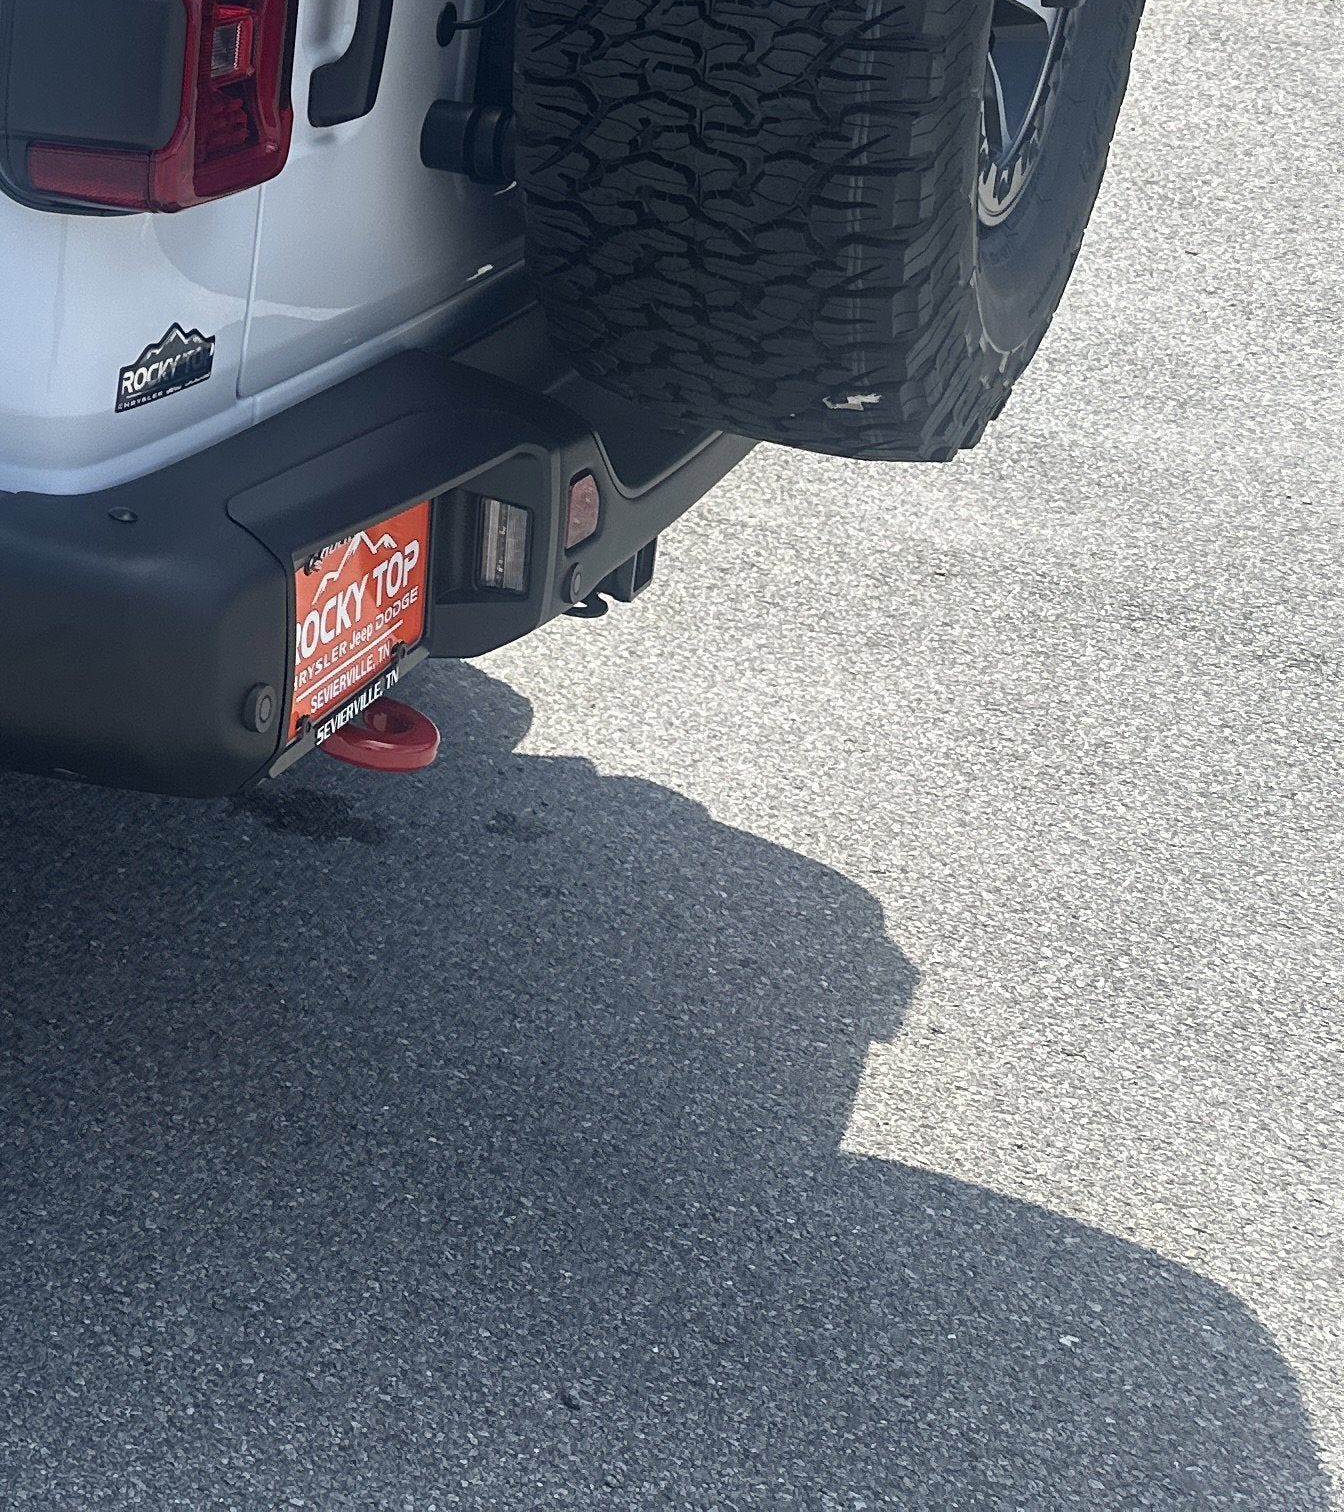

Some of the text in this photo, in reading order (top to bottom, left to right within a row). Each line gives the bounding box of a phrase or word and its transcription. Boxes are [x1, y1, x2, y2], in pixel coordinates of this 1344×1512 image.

[121, 354, 181, 395] ROCKY
[372, 539, 420, 608] TOP
[349, 623, 373, 650] Jeep
[375, 586, 419, 630] DODGE
[378, 641, 391, 663] TN
[385, 666, 400, 690] TN
